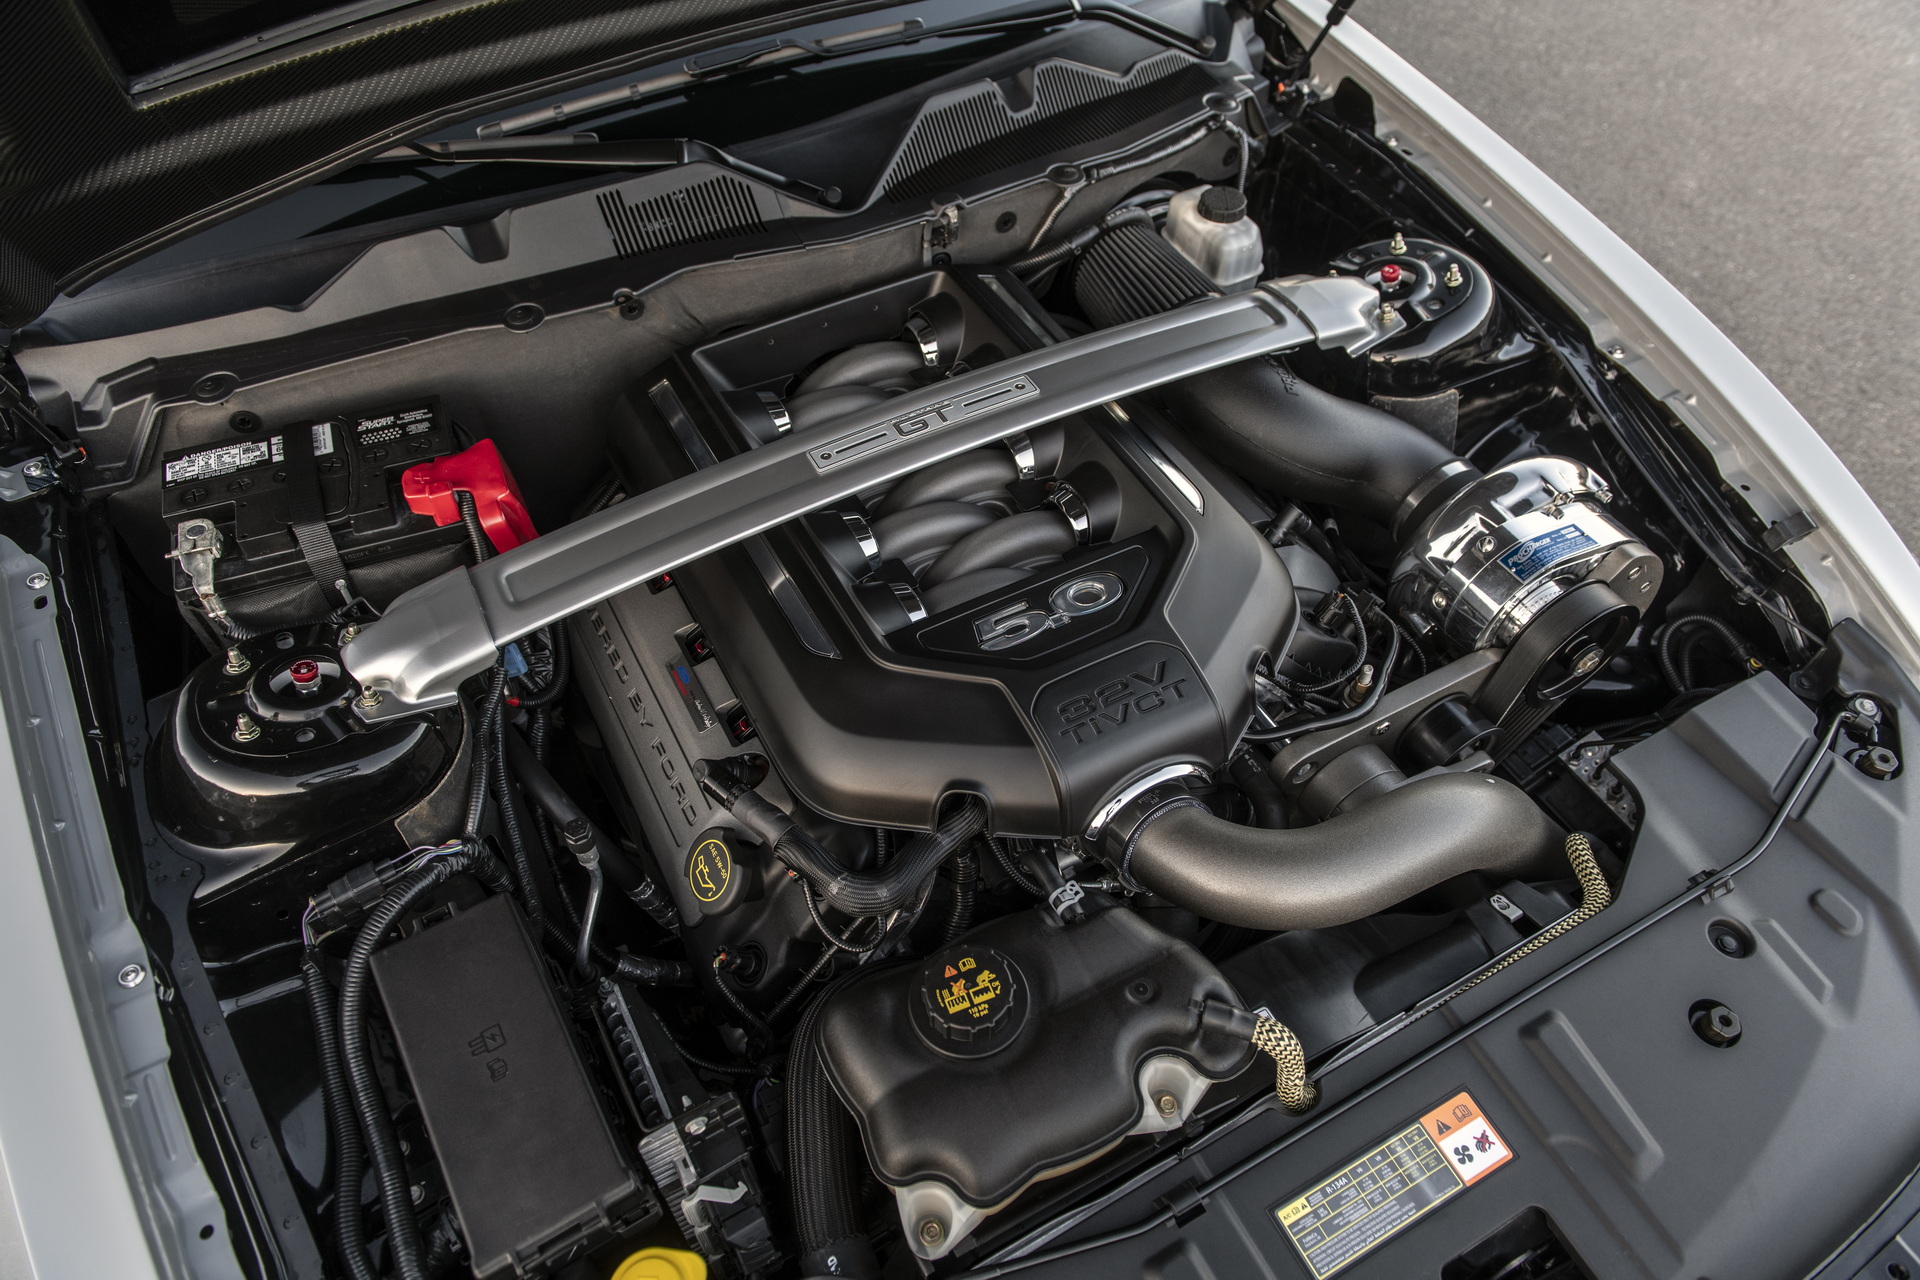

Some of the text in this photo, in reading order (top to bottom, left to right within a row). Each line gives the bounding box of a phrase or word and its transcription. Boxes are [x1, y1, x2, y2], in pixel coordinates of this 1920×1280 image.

[357, 420, 393, 432] START
[361, 415, 395, 427] SUPER
[893, 402, 953, 437] GT
[190, 441, 253, 458] DANGER/POISON
[1508, 537, 1552, 567] PROCHARGER
[973, 571, 1125, 651] 5.0
[1057, 659, 1167, 723] 32V
[588, 605, 629, 684] ERED
[628, 688, 653, 727] BY
[651, 737, 697, 827] FORD
[709, 843, 718, 858] SAE
[992, 980, 1001, 988] OK
[1325, 1176, 1349, 1195] R-134A
